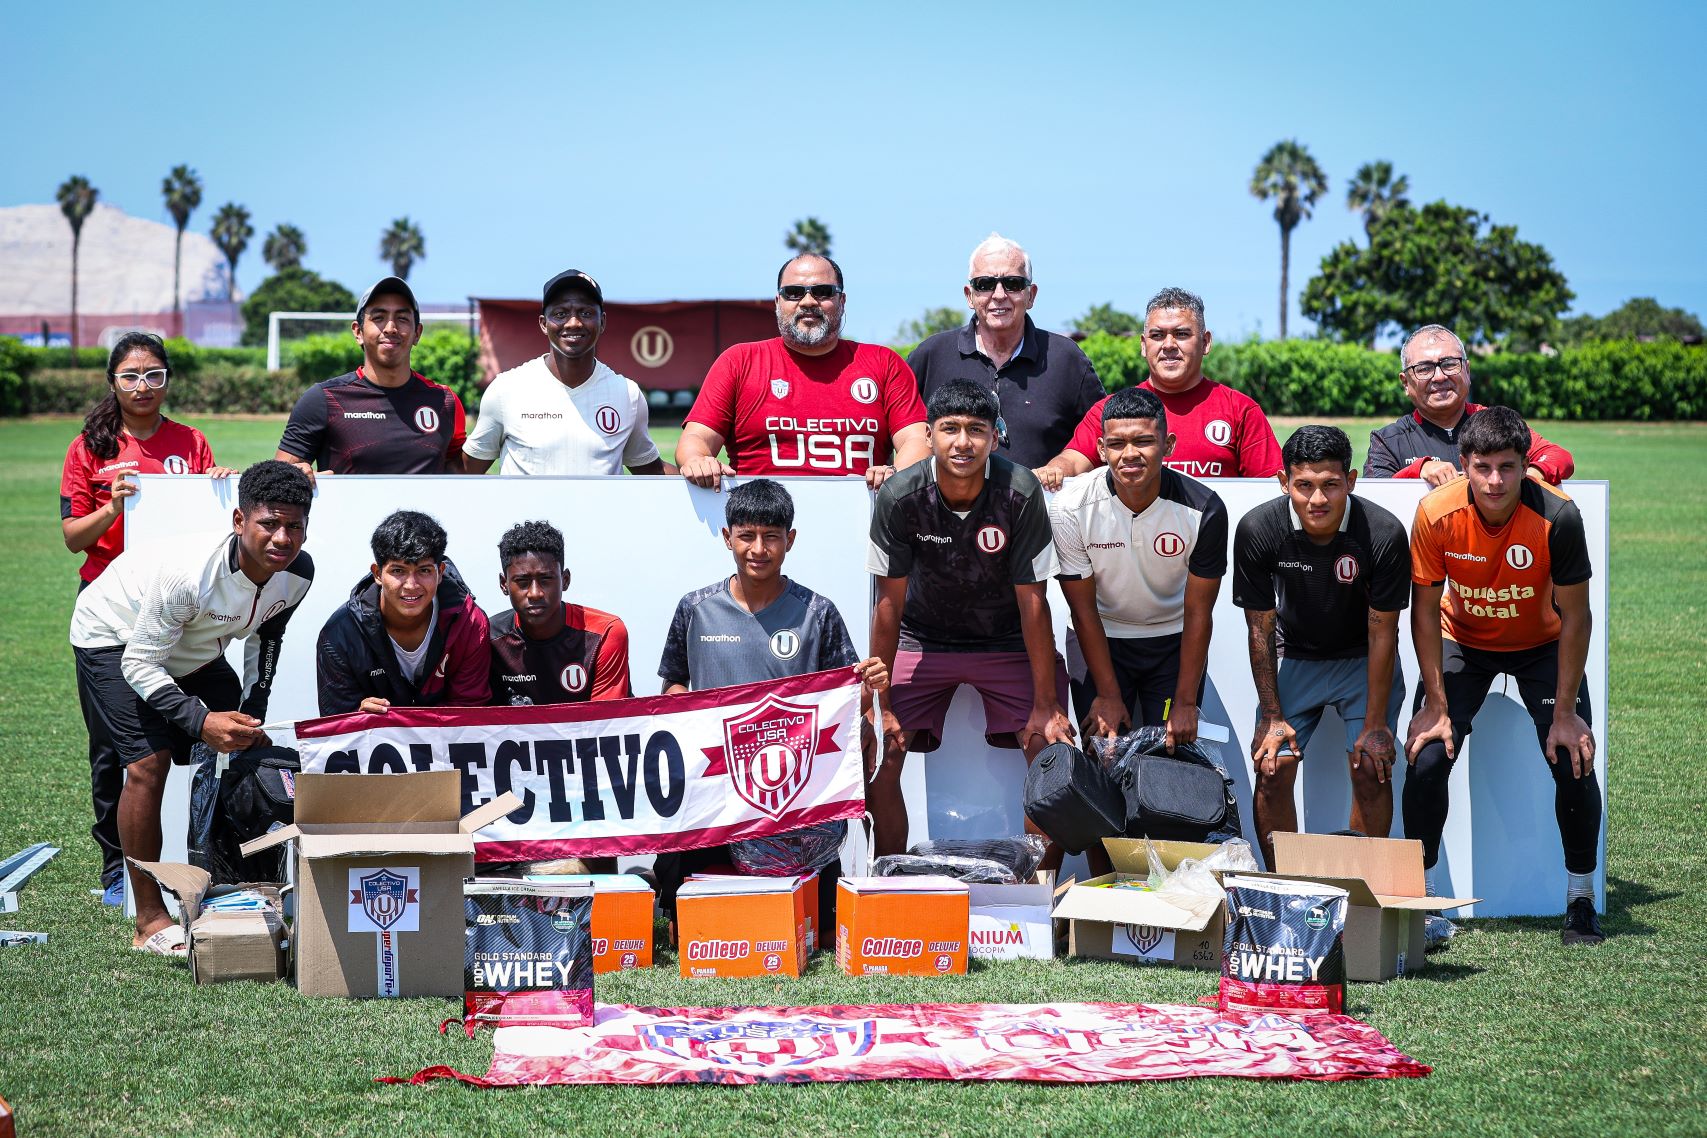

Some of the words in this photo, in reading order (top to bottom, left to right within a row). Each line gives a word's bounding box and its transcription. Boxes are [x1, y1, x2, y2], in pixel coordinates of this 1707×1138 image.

[640, 333, 664, 361] U
[857, 383, 872, 400] U
[343, 411, 387, 420] marathon
[520, 411, 563, 420] marathon
[601, 411, 615, 431] U
[765, 416, 879, 432] COLECTIVO
[768, 433, 875, 469] USA
[98, 460, 139, 474] marathon
[916, 532, 953, 544] marathon
[982, 530, 1000, 551] U
[1086, 541, 1126, 551] marathon
[1160, 537, 1178, 555] U
[1444, 551, 1487, 563] marathon
[1511, 548, 1528, 568] U
[1449, 578, 1536, 603] apuesta
[1464, 599, 1520, 619] total
[700, 633, 741, 642] marathon
[777, 635, 793, 655] U
[502, 674, 537, 683] marathon
[566, 669, 583, 689] U
[738, 715, 805, 733] COLECTIVO
[757, 729, 787, 741] USA
[760, 750, 787, 787] U
[378, 897, 391, 914] U
[613, 939, 645, 950] DELUXE
[688, 939, 750, 961] College
[755, 940, 788, 952] DELUXE
[861, 937, 924, 959] College
[928, 941, 960, 953] DELUXE
[474, 952, 499, 960] GOLD
[502, 952, 553, 960] STANDARD
[624, 954, 634, 964] 25
[767, 956, 778, 966] 25
[938, 956, 949, 966] 25
[1193, 951, 1214, 961] 6362
[1229, 950, 1240, 975] 100%
[473, 961, 484, 988] 100%
[484, 960, 575, 987] WHEY
[1240, 952, 1325, 981] WHEY
